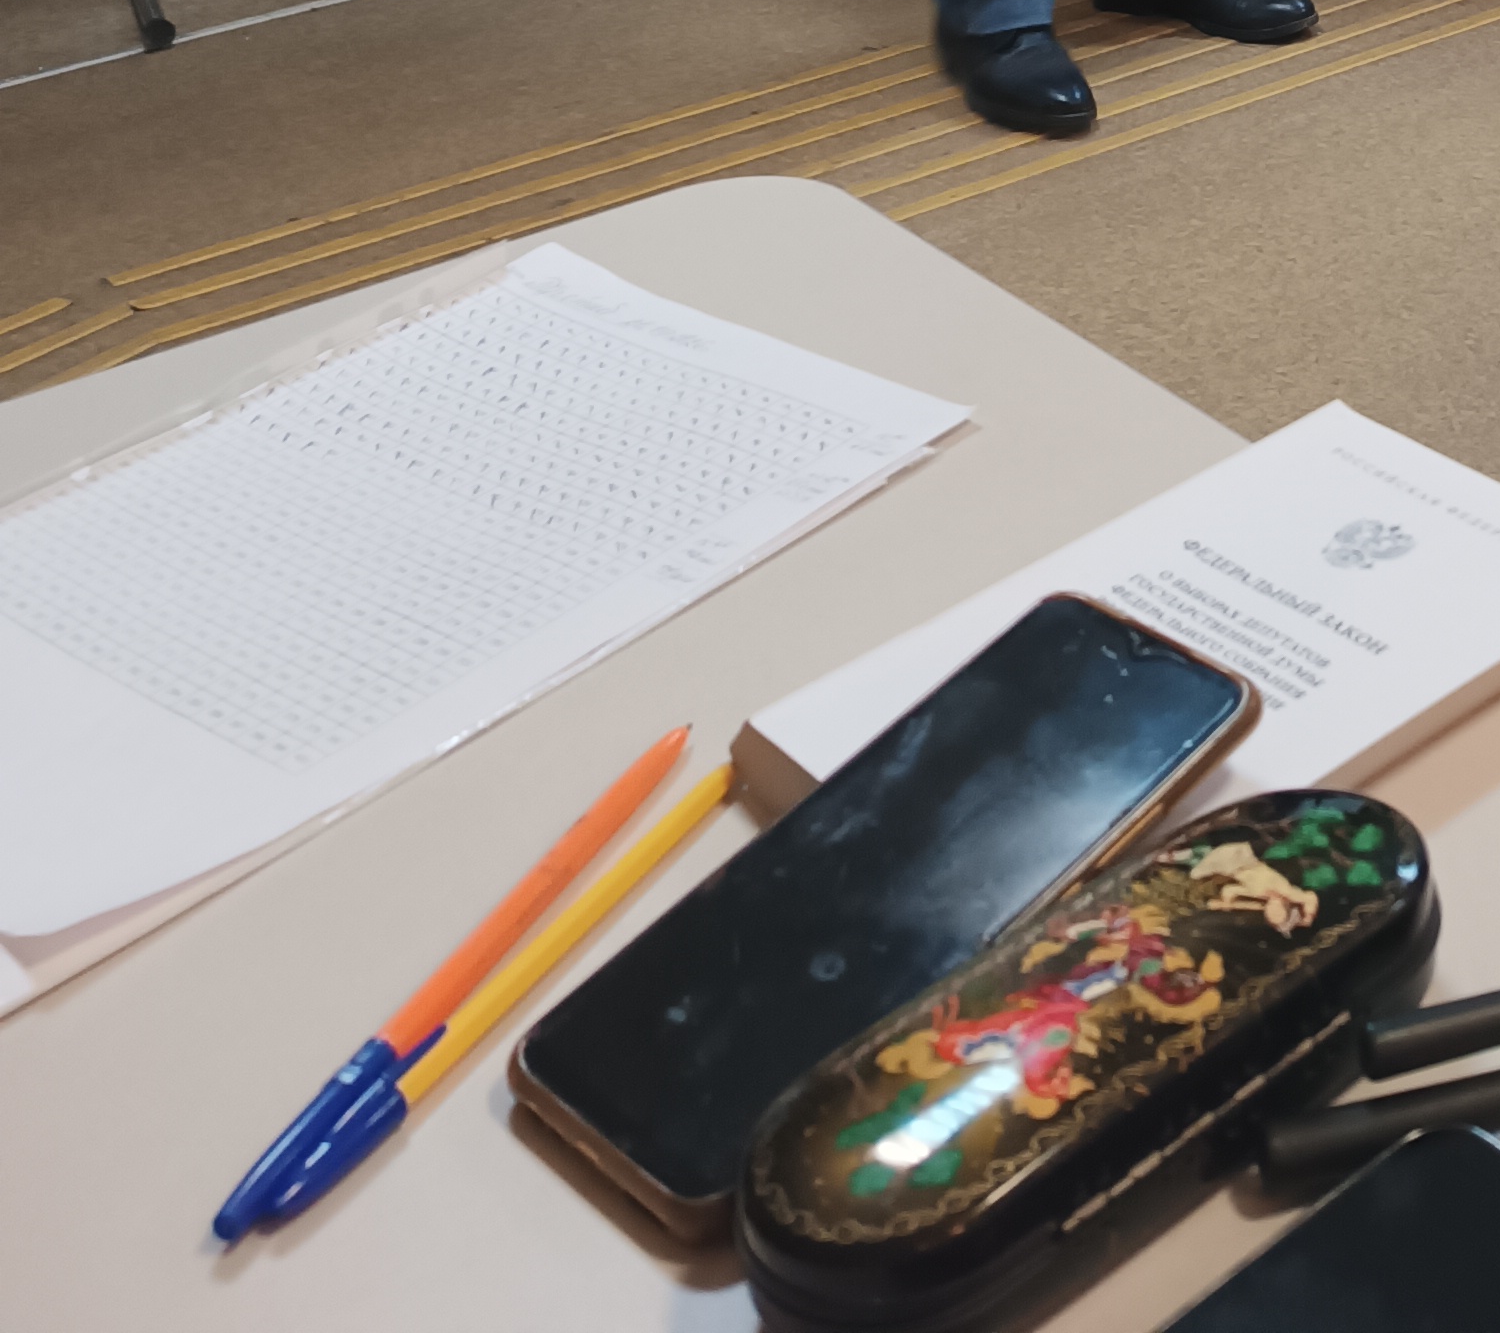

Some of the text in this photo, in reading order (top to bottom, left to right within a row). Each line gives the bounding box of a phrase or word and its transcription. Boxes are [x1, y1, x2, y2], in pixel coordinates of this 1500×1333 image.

[1111, 584, 1306, 699] ФЕДЕРАЛЬНОГО СОБРАНИЯ
[1128, 572, 1325, 687] ГОСУДАРСТВЕННОЙ ДУМЫ
[1157, 569, 1331, 669] О ВЫБОРАХ ДЕПУТАТОВ
[1182, 538, 1389, 656] ФЕДЕРАЛЬНЫЙ ЗАКОН
